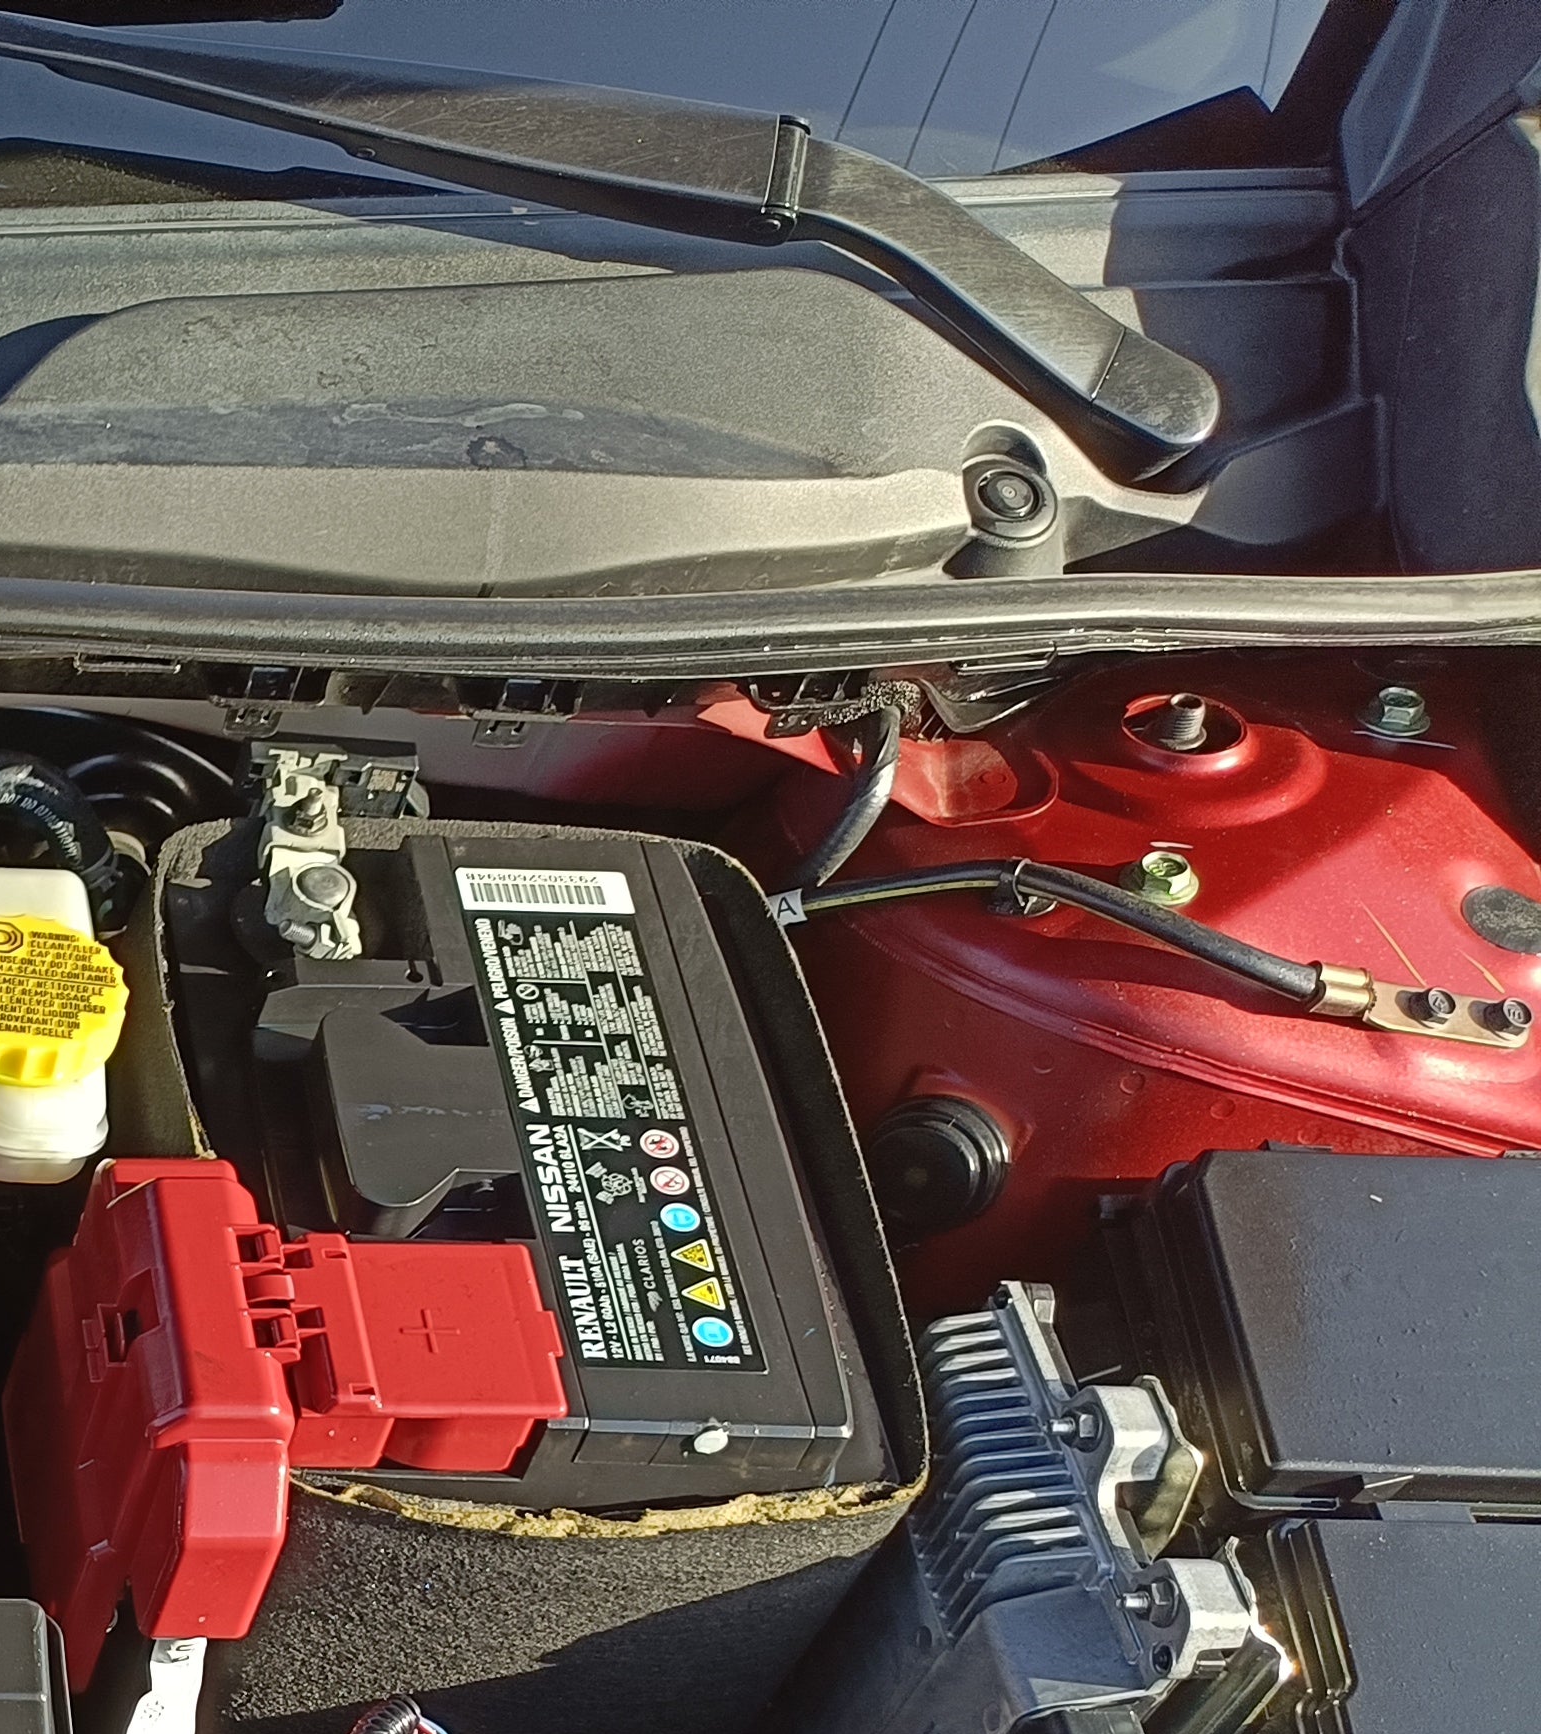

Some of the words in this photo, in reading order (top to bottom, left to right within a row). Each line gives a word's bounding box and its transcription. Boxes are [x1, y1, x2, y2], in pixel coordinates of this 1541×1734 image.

[29, 940, 66, 950] CLEAN
[66, 944, 101, 954] FILLER
[29, 949, 50, 957] CAP
[54, 952, 92, 962] BEFORE
[473, 918, 509, 997] PELIGRO/VENENO
[16, 965, 58, 977] SEALED
[19, 957, 46, 967] ONLY
[48, 960, 68, 969] DOT
[80, 963, 115, 974] BRAKE
[4, 986, 18, 994] DE
[20, 987, 93, 1003] REMPLISSAGE
[35, 980, 89, 993] NETTOYER
[90, 986, 105, 995] LE
[41, 1007, 80, 1019] LIQUIDE
[499, 1017, 534, 1096] DANGER/POISON
[524, 1122, 576, 1232] NISSAN
[560, 1160, 582, 1193] 24410
[580, 1237, 601, 1265] (SAE)
[630, 1238, 657, 1289] CLARIOS
[588, 1265, 607, 1288] 510A
[564, 1255, 608, 1359] RENAULT
[607, 1339, 625, 1358] 12V
